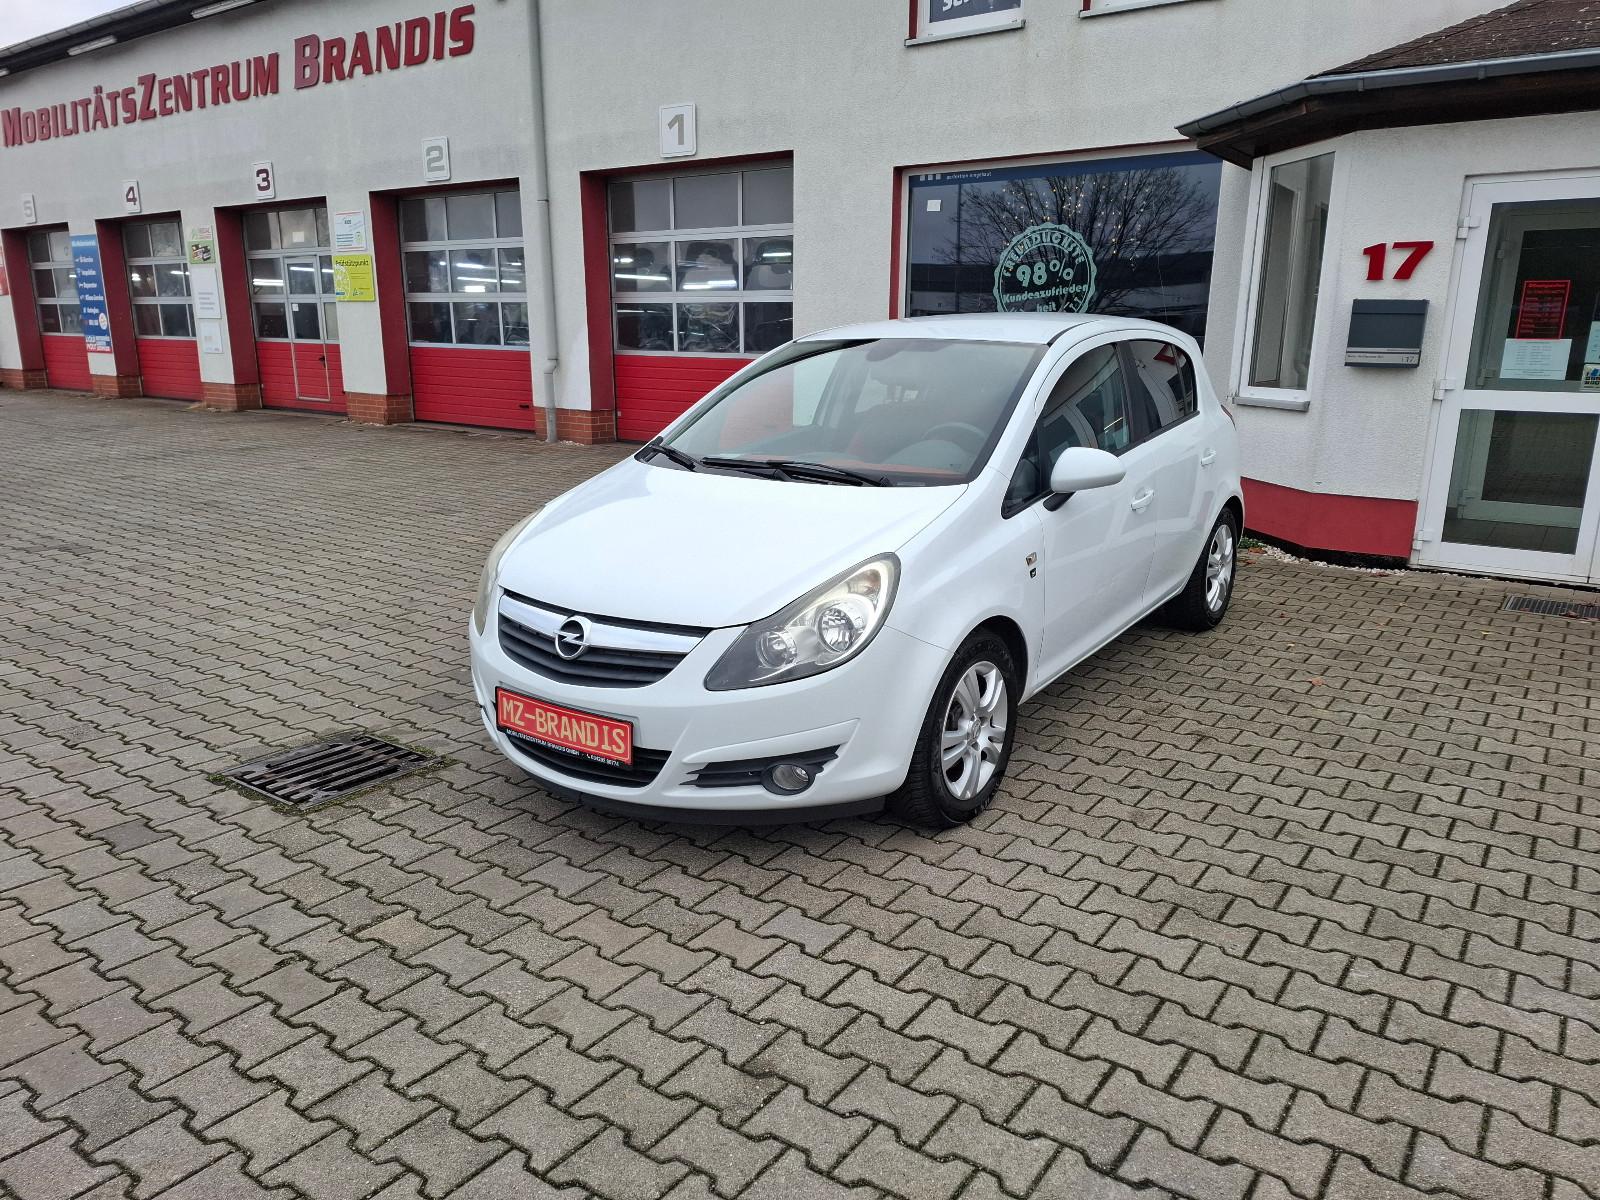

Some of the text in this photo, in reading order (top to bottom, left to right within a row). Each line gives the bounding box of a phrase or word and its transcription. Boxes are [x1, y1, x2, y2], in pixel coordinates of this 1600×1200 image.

[294, 4, 476, 90] BRANDIS
[667, 113, 685, 146] 1
[426, 145, 445, 173] 2
[255, 168, 271, 191] 3
[23, 200, 33, 218] 5
[125, 185, 138, 206] 4
[1362, 240, 1435, 281] 17
[502, 697, 625, 754] MZ-BRANDIS
